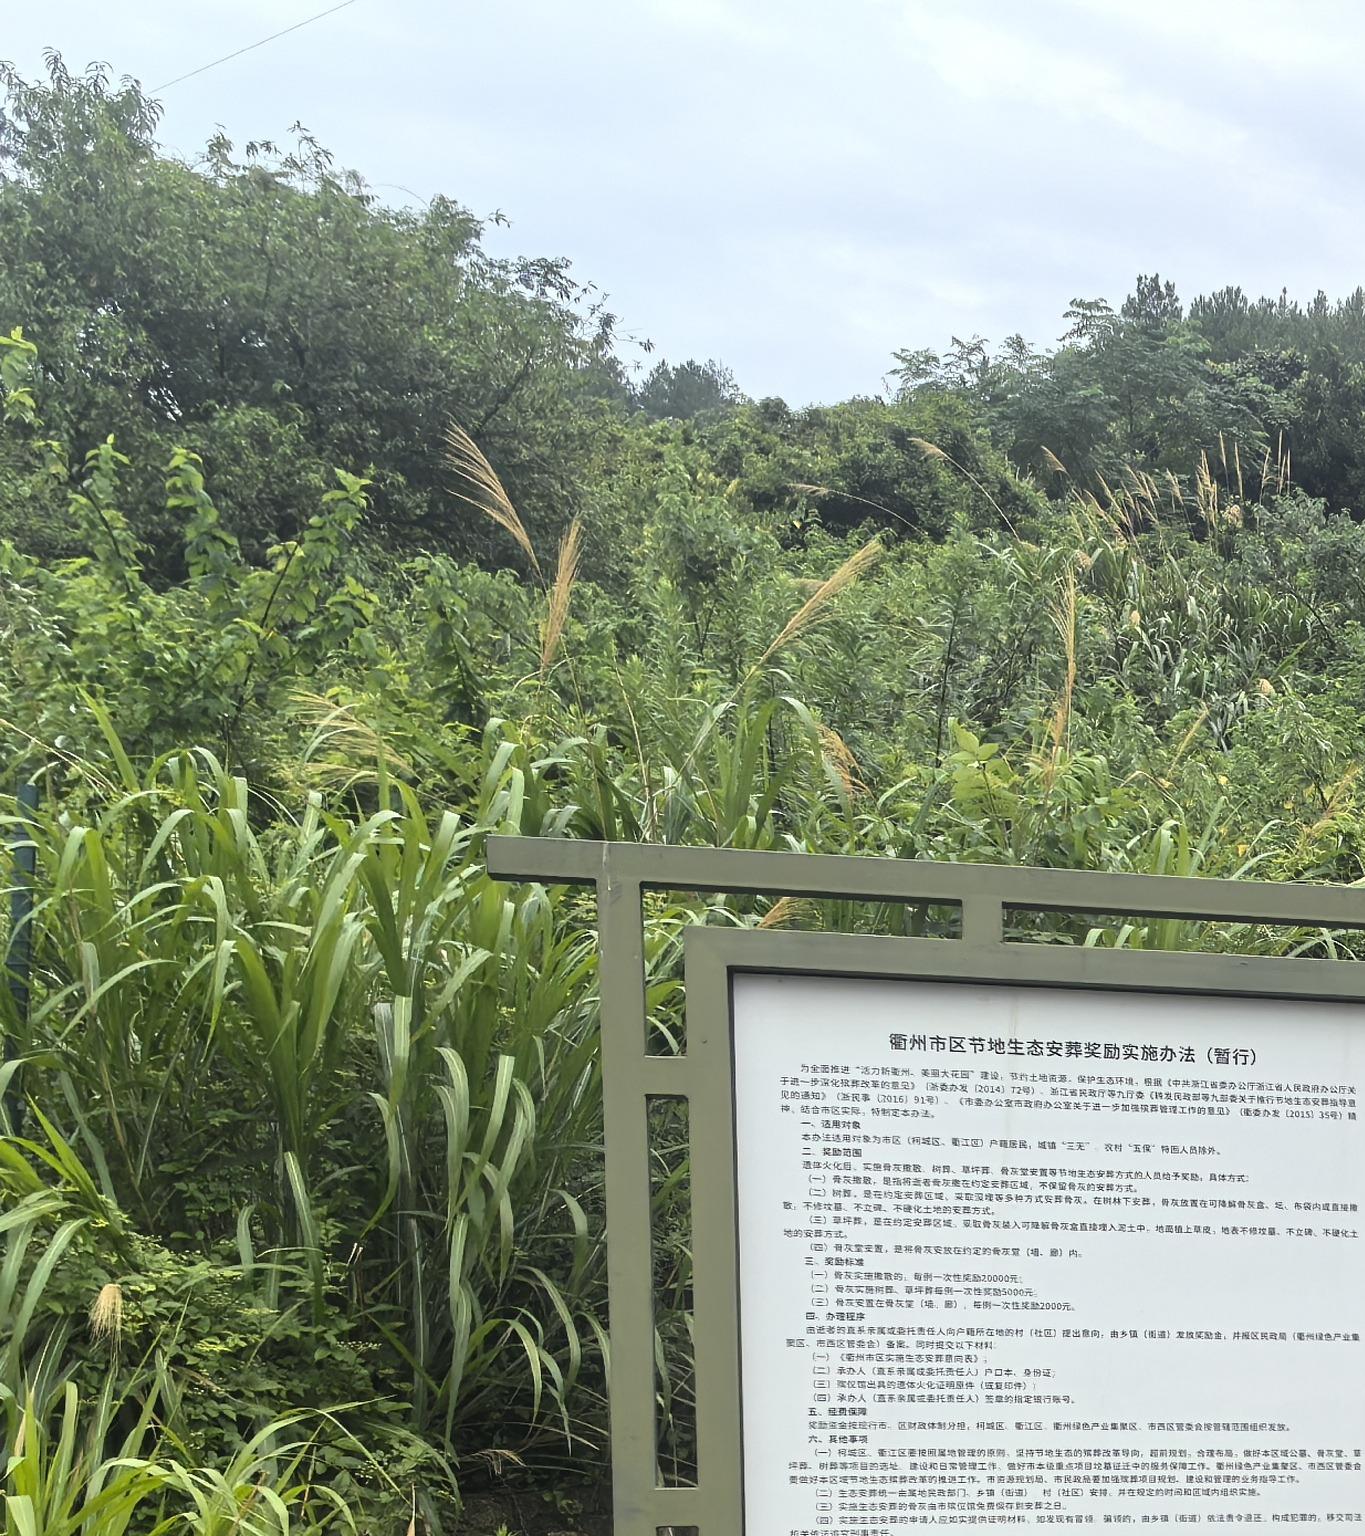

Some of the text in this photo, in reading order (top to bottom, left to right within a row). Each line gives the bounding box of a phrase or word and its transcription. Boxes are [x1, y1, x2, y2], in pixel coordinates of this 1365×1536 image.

[888, 1032, 1256, 1066] 衢州市区节地生态安葬奖励实施办法（暂行）
[800, 1118, 861, 1130] 一、适用对象
